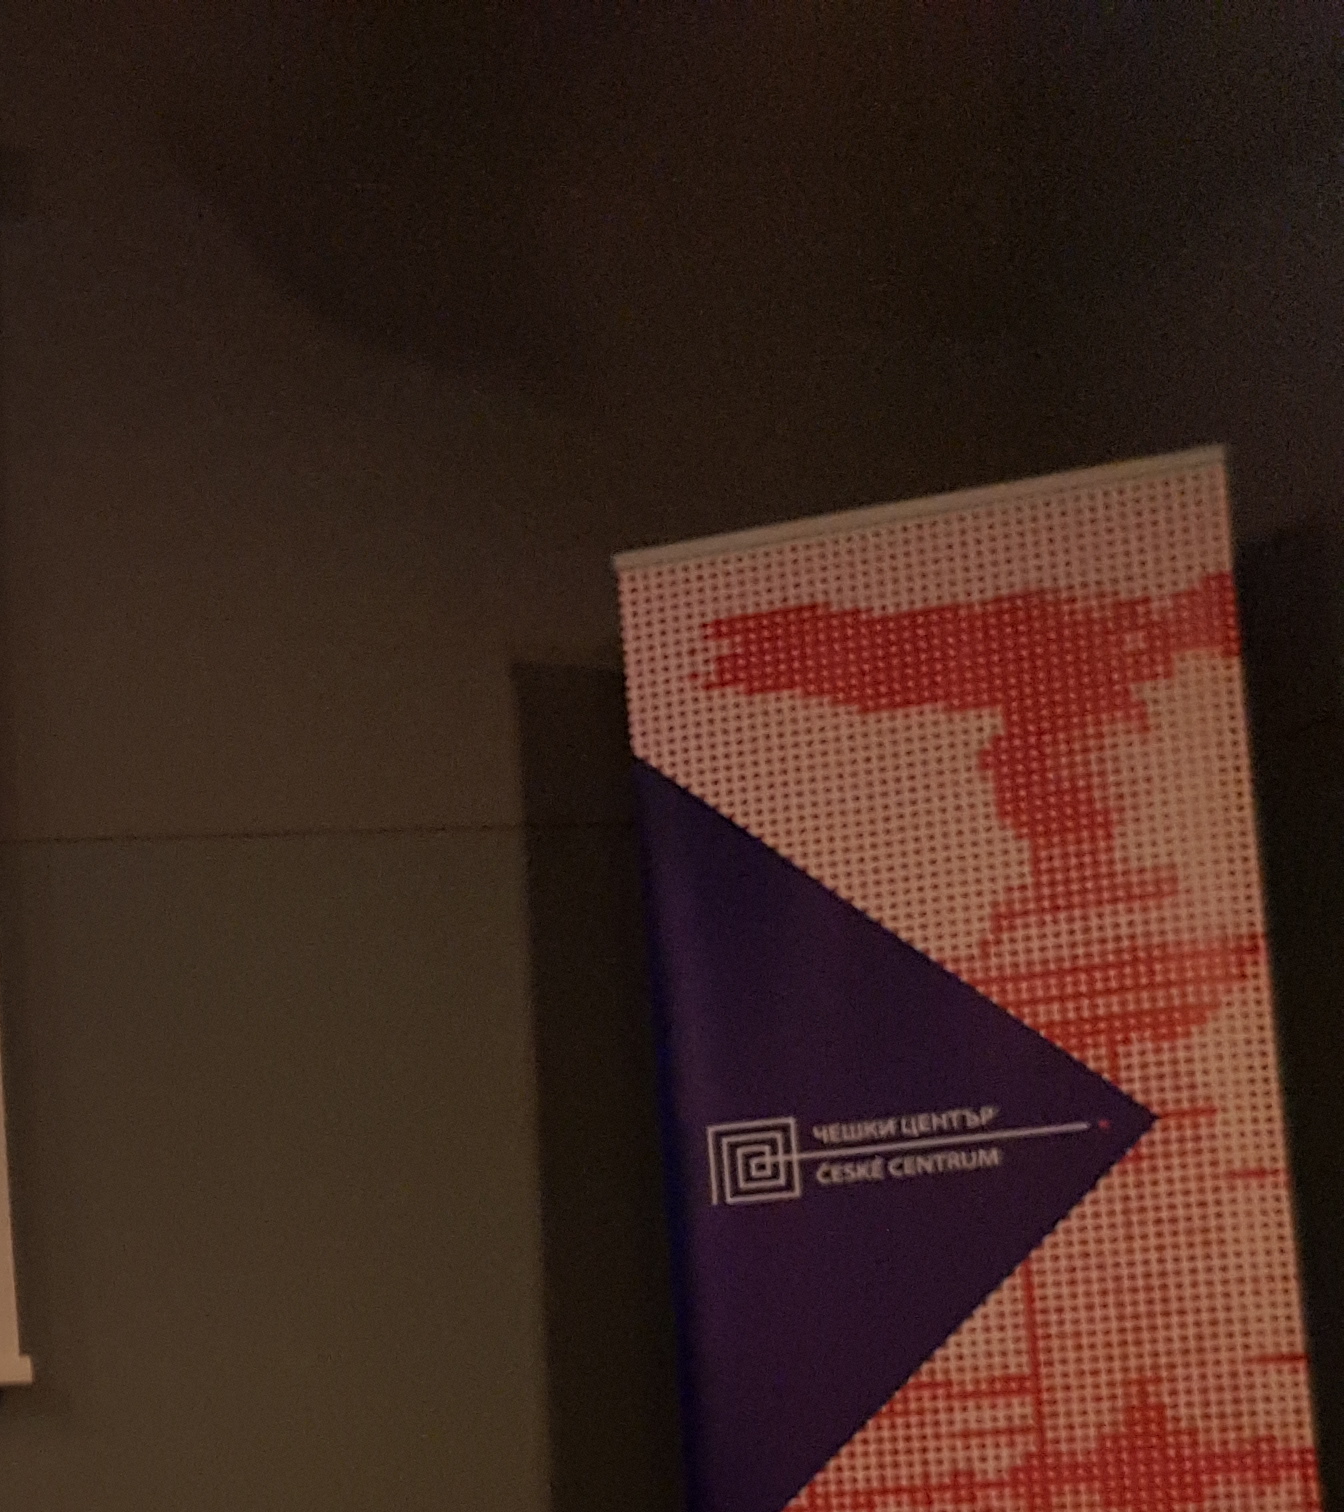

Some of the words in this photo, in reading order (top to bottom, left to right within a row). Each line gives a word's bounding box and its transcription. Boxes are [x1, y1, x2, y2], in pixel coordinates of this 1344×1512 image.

[812, 1119, 897, 1145] ЧЕШКИ
[900, 1104, 1000, 1138] ЦЕНТЪР
[887, 1147, 1000, 1178] CENTRUM
